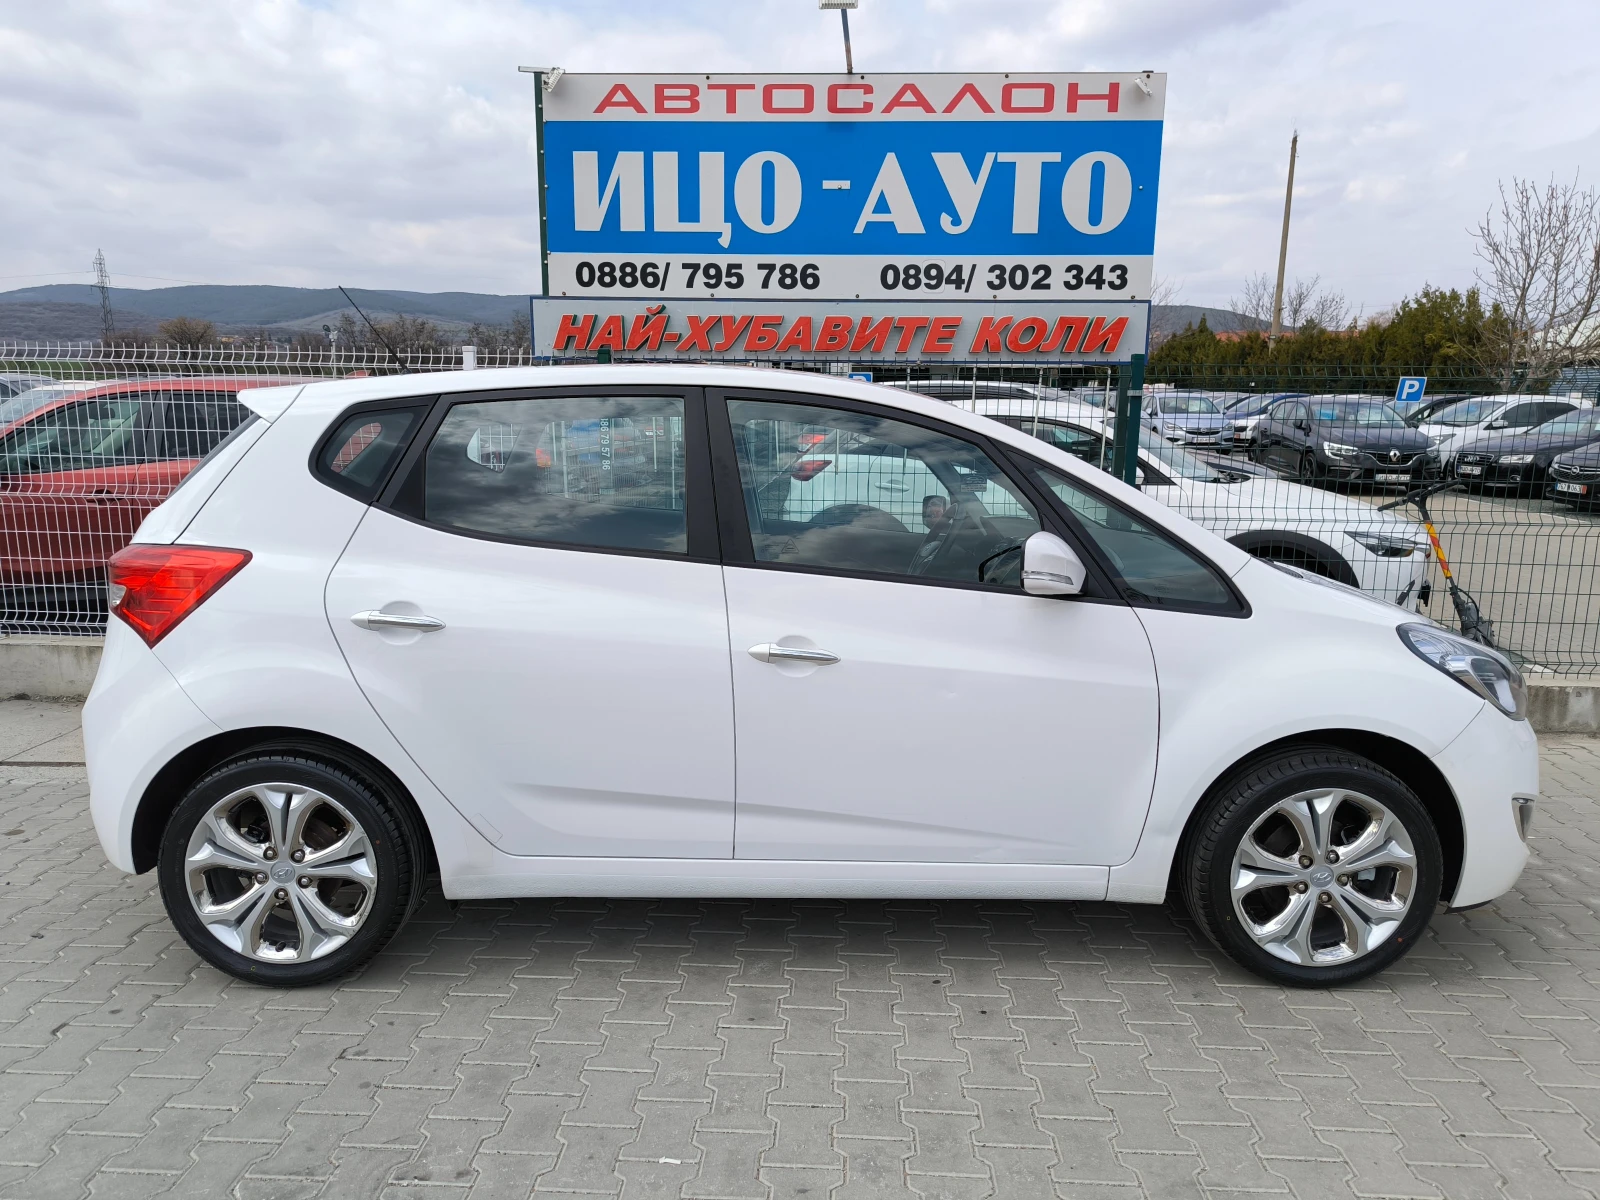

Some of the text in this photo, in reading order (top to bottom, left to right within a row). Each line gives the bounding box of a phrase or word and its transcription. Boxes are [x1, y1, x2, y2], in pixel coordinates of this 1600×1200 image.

[592, 81, 1120, 114] АВТОСАЛОН
[575, 261, 821, 291] 0886/ 795 786
[879, 263, 1129, 293] 0894/ 302 343
[552, 304, 1130, 354] НАЙ-ХУБАВИТЕ КОЛИ
[1401, 380, 1420, 400] P
